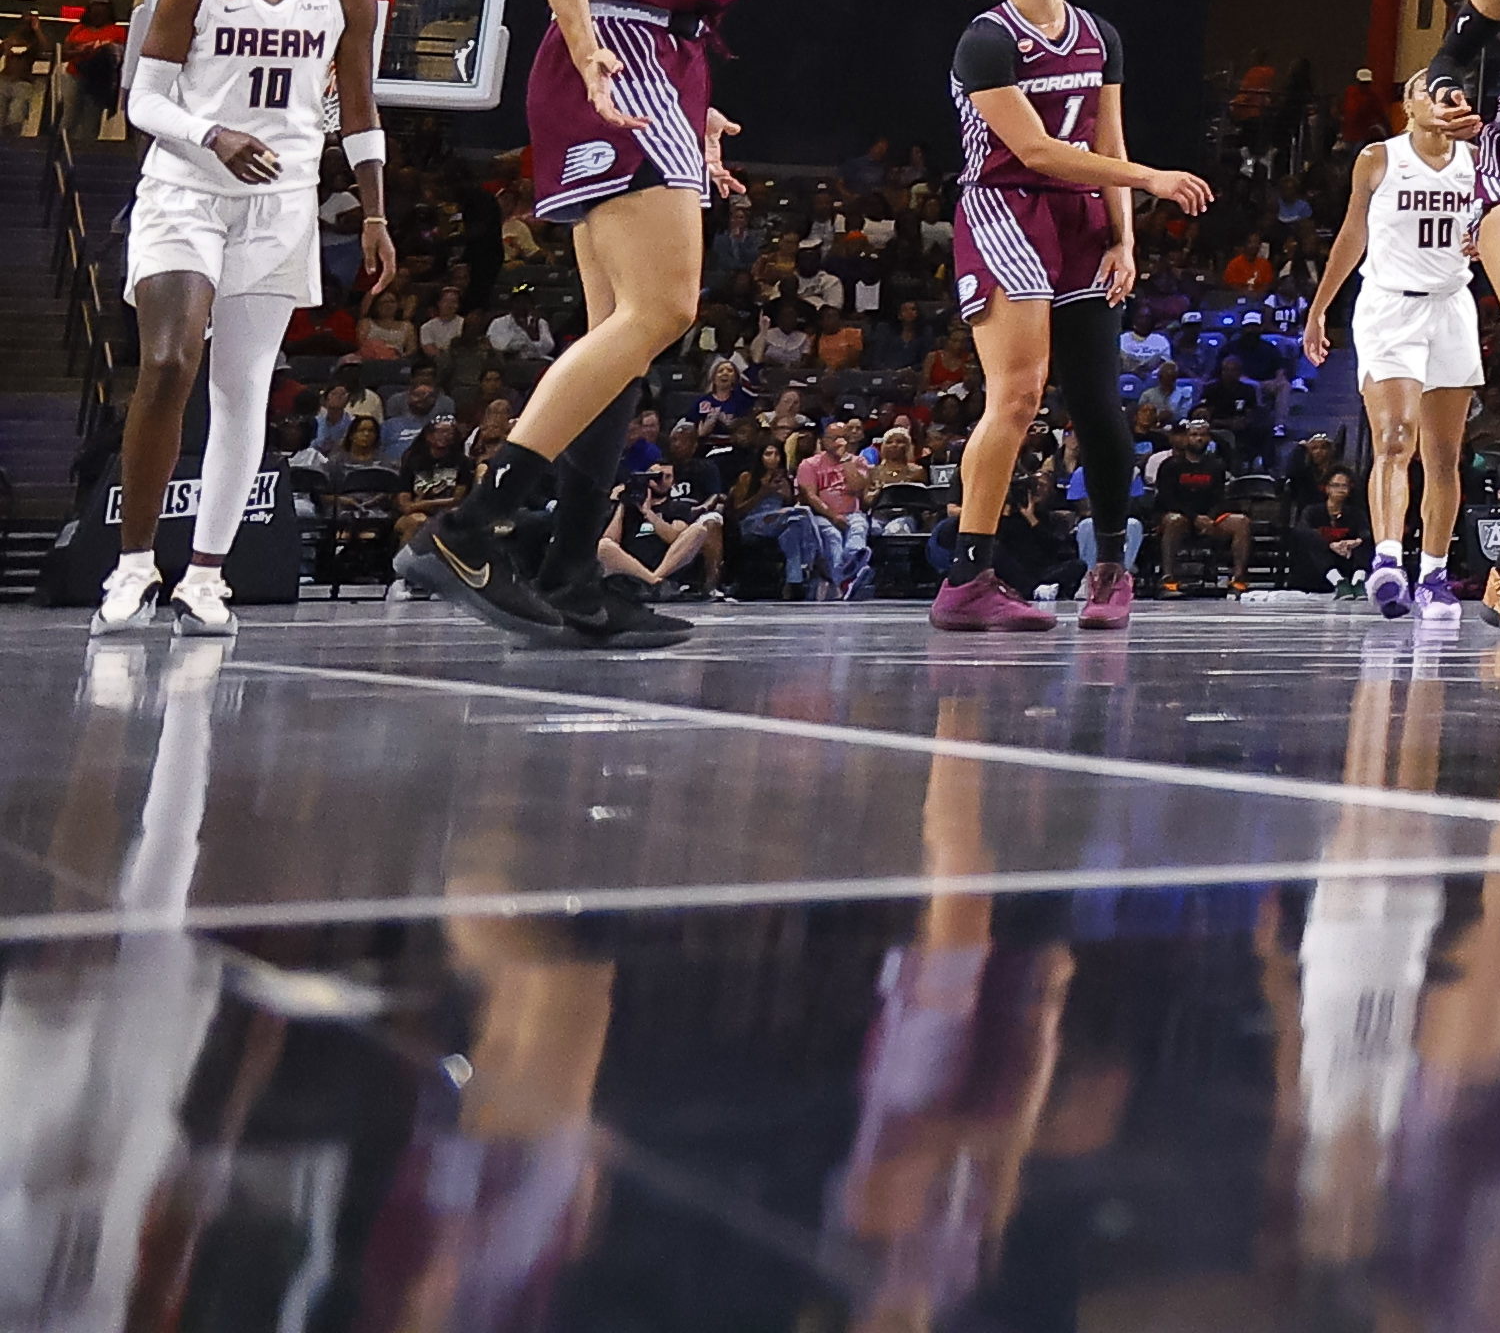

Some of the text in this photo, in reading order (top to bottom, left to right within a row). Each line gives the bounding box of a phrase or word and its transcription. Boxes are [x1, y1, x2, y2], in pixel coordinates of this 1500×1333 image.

[214, 26, 327, 59] DREAM
[248, 66, 293, 109] 10
[1057, 95, 1085, 139] 1
[1397, 190, 1472, 213] DREAM
[1418, 217, 1454, 249] 00
